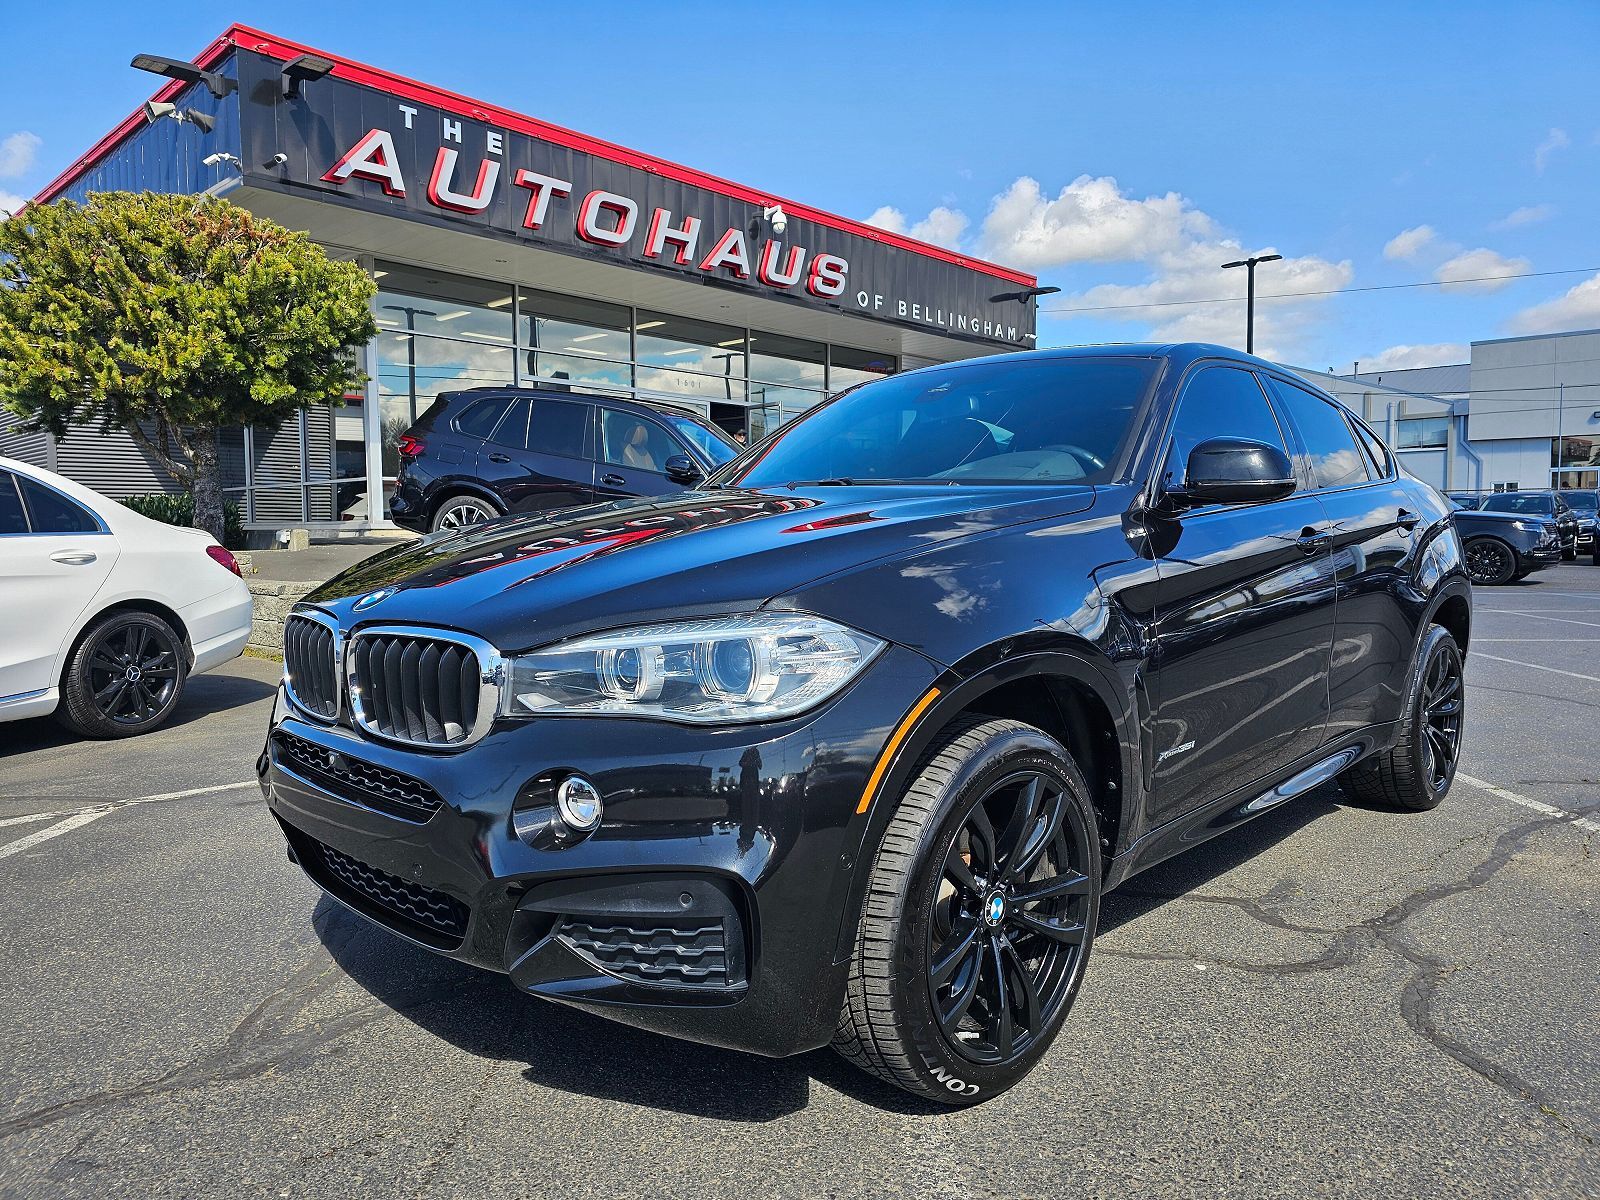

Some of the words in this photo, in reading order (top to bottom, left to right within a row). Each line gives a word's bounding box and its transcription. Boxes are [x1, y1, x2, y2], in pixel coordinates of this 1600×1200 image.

[398, 104, 504, 156] THE
[320, 127, 850, 299] AUTOHAUS
[857, 290, 884, 310] OF
[898, 300, 1017, 341] BELLINGHAM
